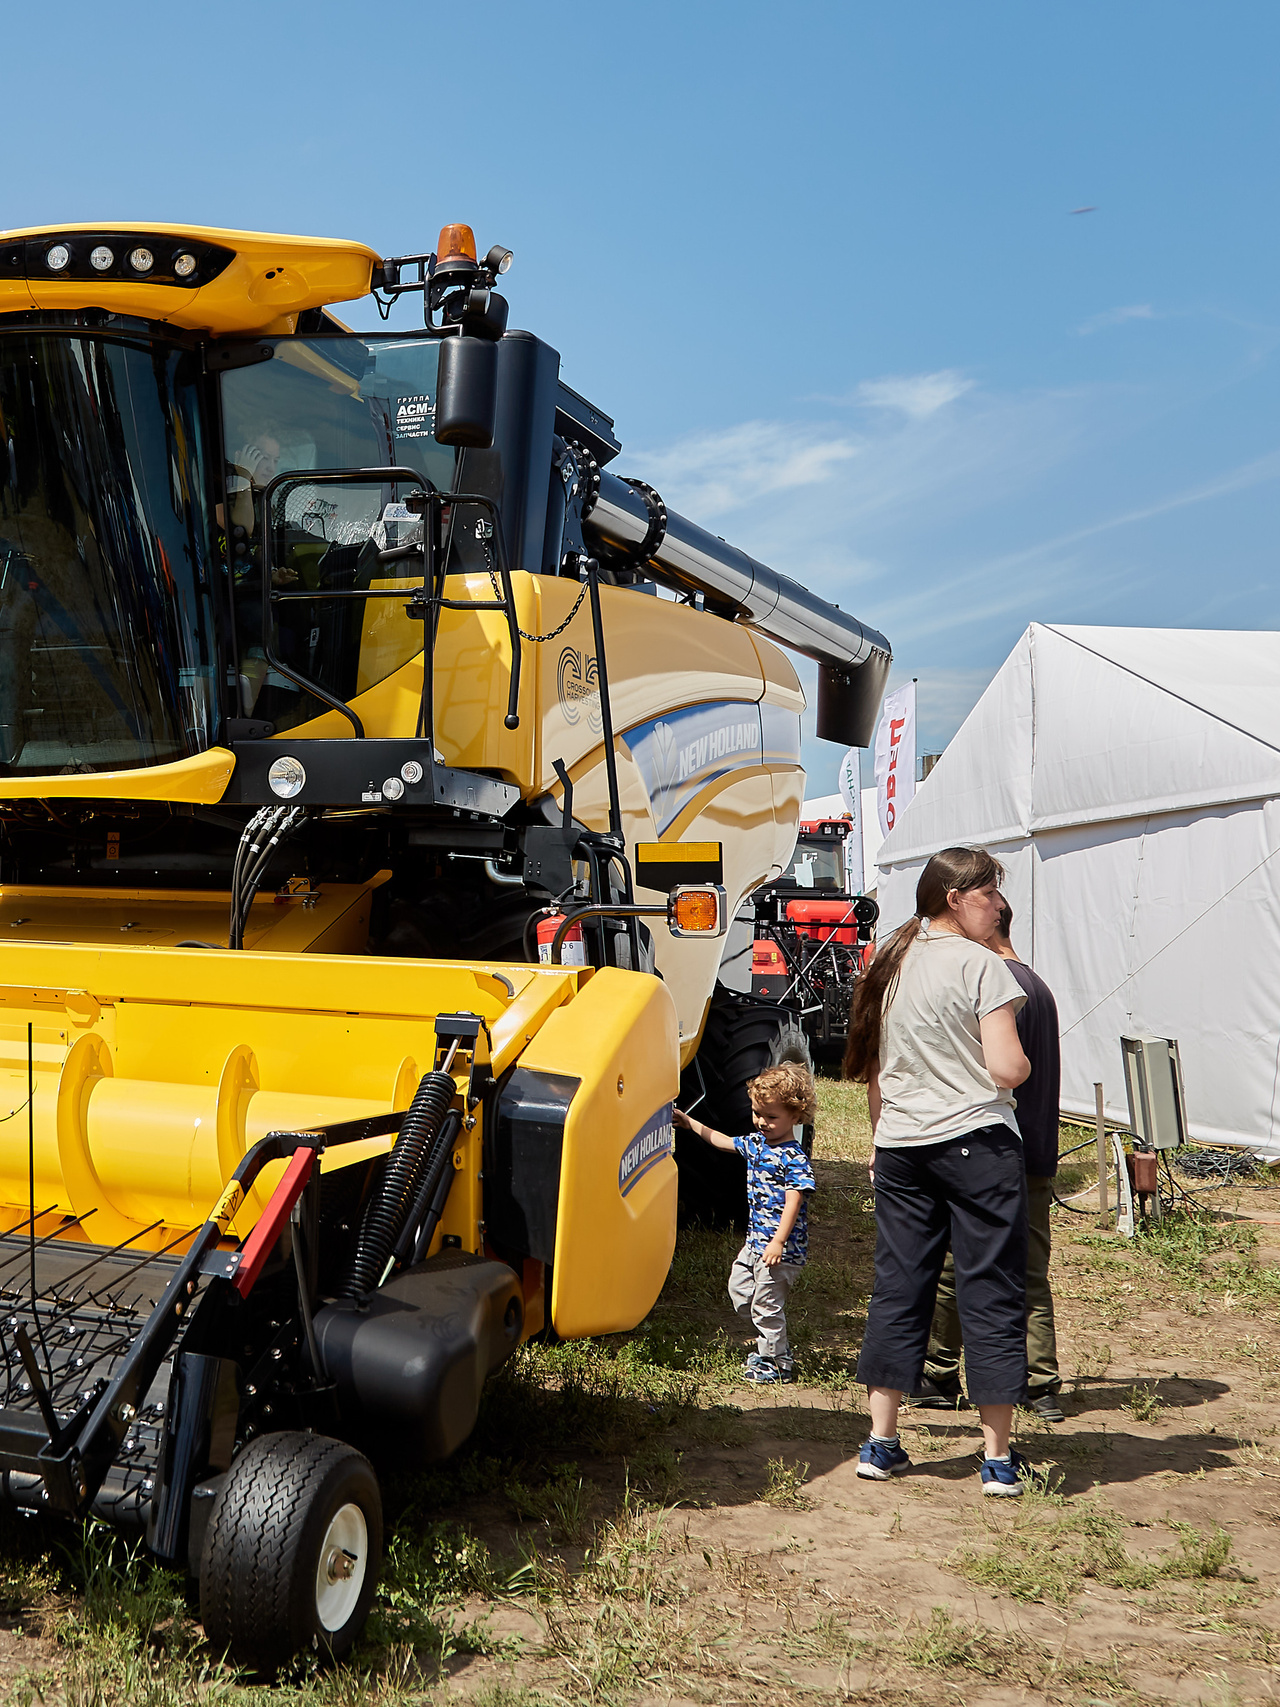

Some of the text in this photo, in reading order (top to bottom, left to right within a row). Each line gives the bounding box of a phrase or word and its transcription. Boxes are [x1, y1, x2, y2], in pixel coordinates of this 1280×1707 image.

[397, 395, 430, 404] ГРУППА
[396, 416, 426, 424] ТЕХНИКА
[395, 431, 429, 439] ЗАПЧАСТИ
[679, 723, 759, 781] NEW HOLLAND
[568, 942, 574, 950] 6
[621, 1142, 640, 1181] NEW
